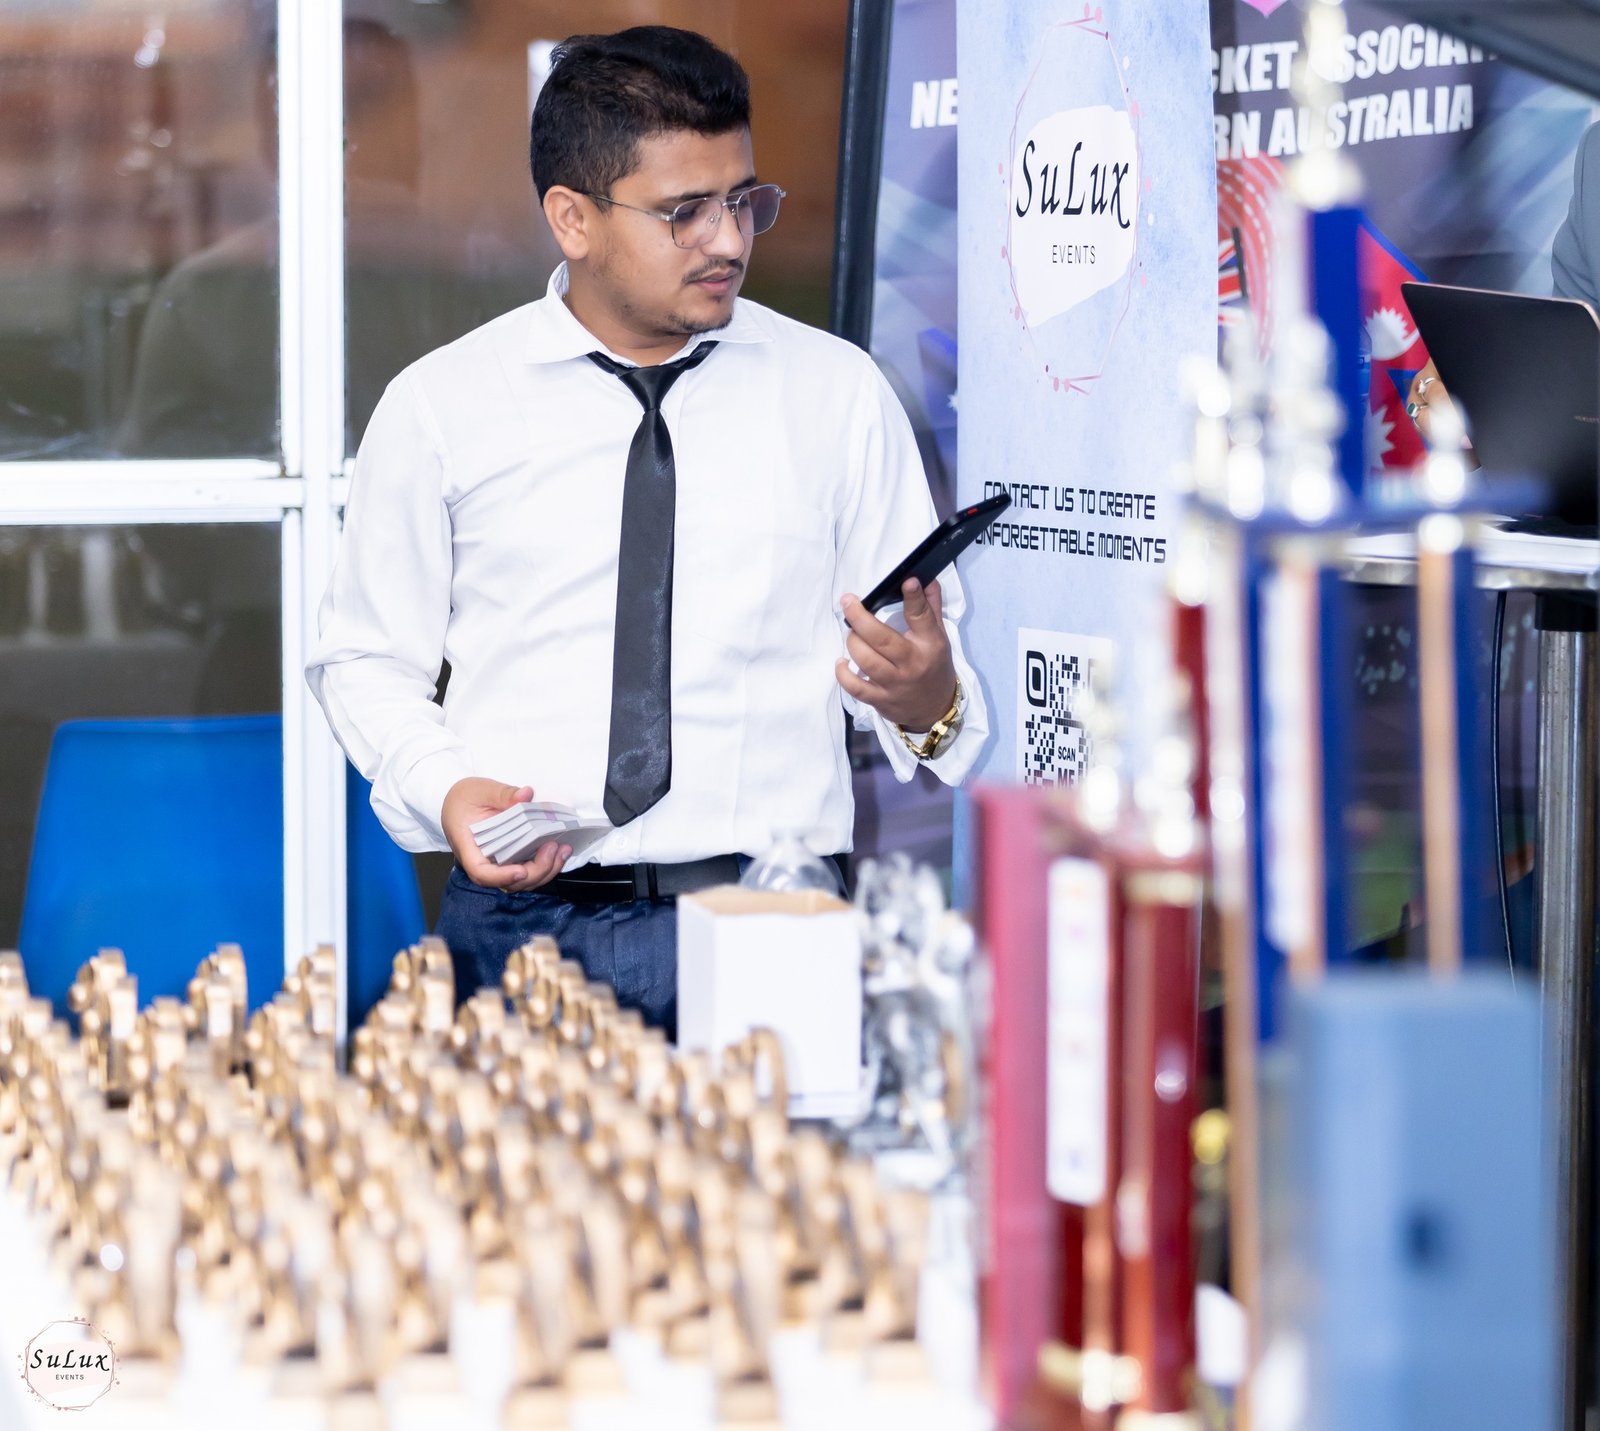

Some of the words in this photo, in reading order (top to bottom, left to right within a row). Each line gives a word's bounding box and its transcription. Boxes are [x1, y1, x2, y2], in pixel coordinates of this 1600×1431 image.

[1015, 139, 1131, 230] SuLux
[1052, 244, 1096, 265] EVENTS
[1054, 486, 1074, 512] US
[1079, 488, 1096, 514] TO
[1099, 490, 1156, 520] CREATE
[1098, 532, 1167, 564] MOMENTS
[1057, 745, 1076, 762] SCAN
